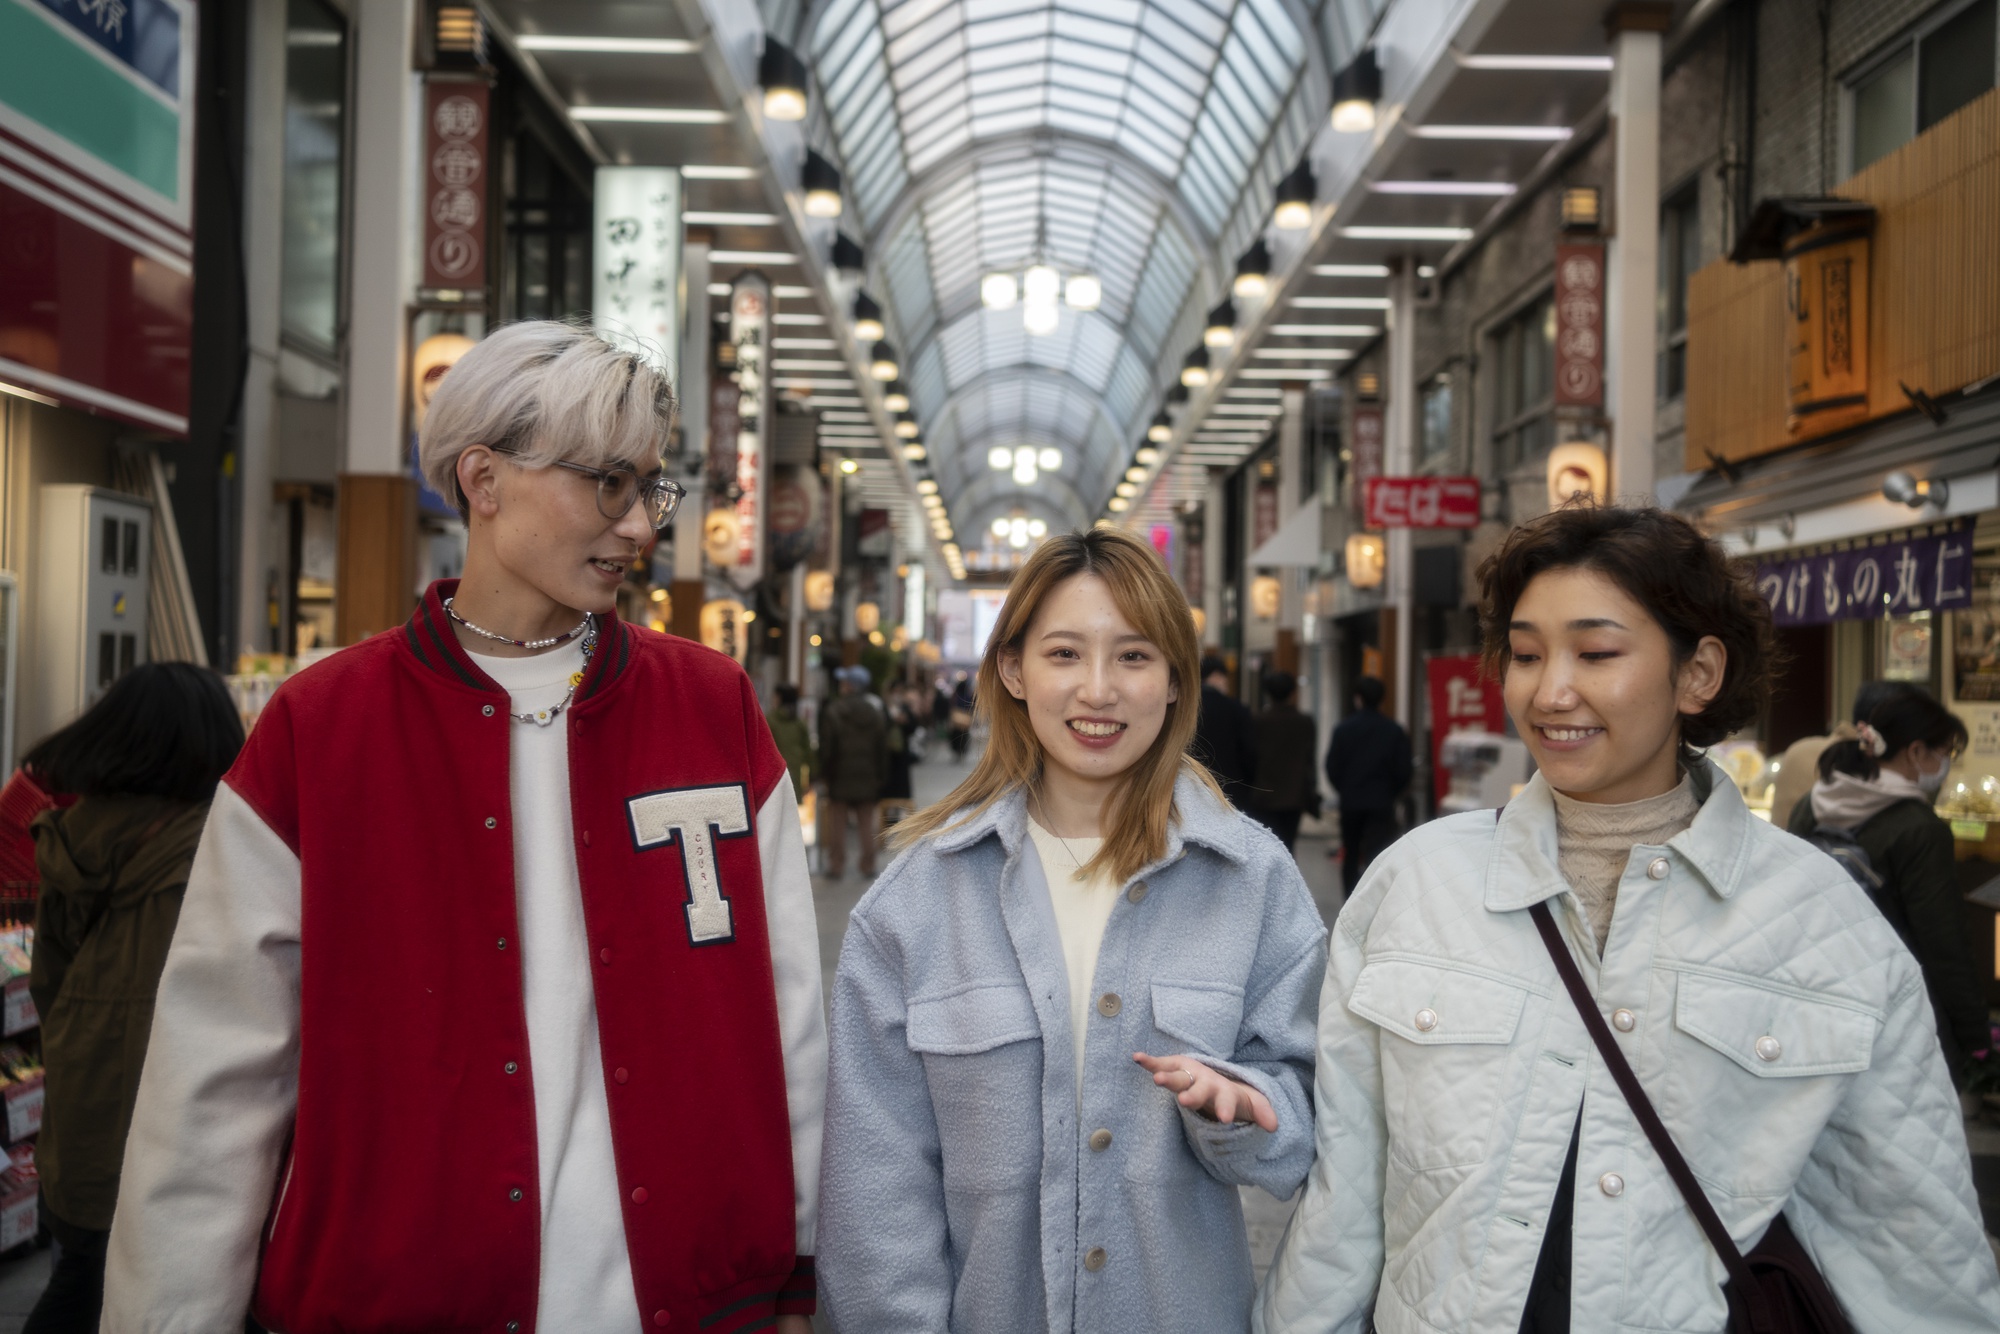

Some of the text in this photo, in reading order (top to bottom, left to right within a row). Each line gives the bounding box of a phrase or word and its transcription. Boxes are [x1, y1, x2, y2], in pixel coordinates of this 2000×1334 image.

[1374, 482, 1476, 526] たばこ
[1757, 540, 1966, 619] つけもの丸仁
[626, 783, 752, 946] T
